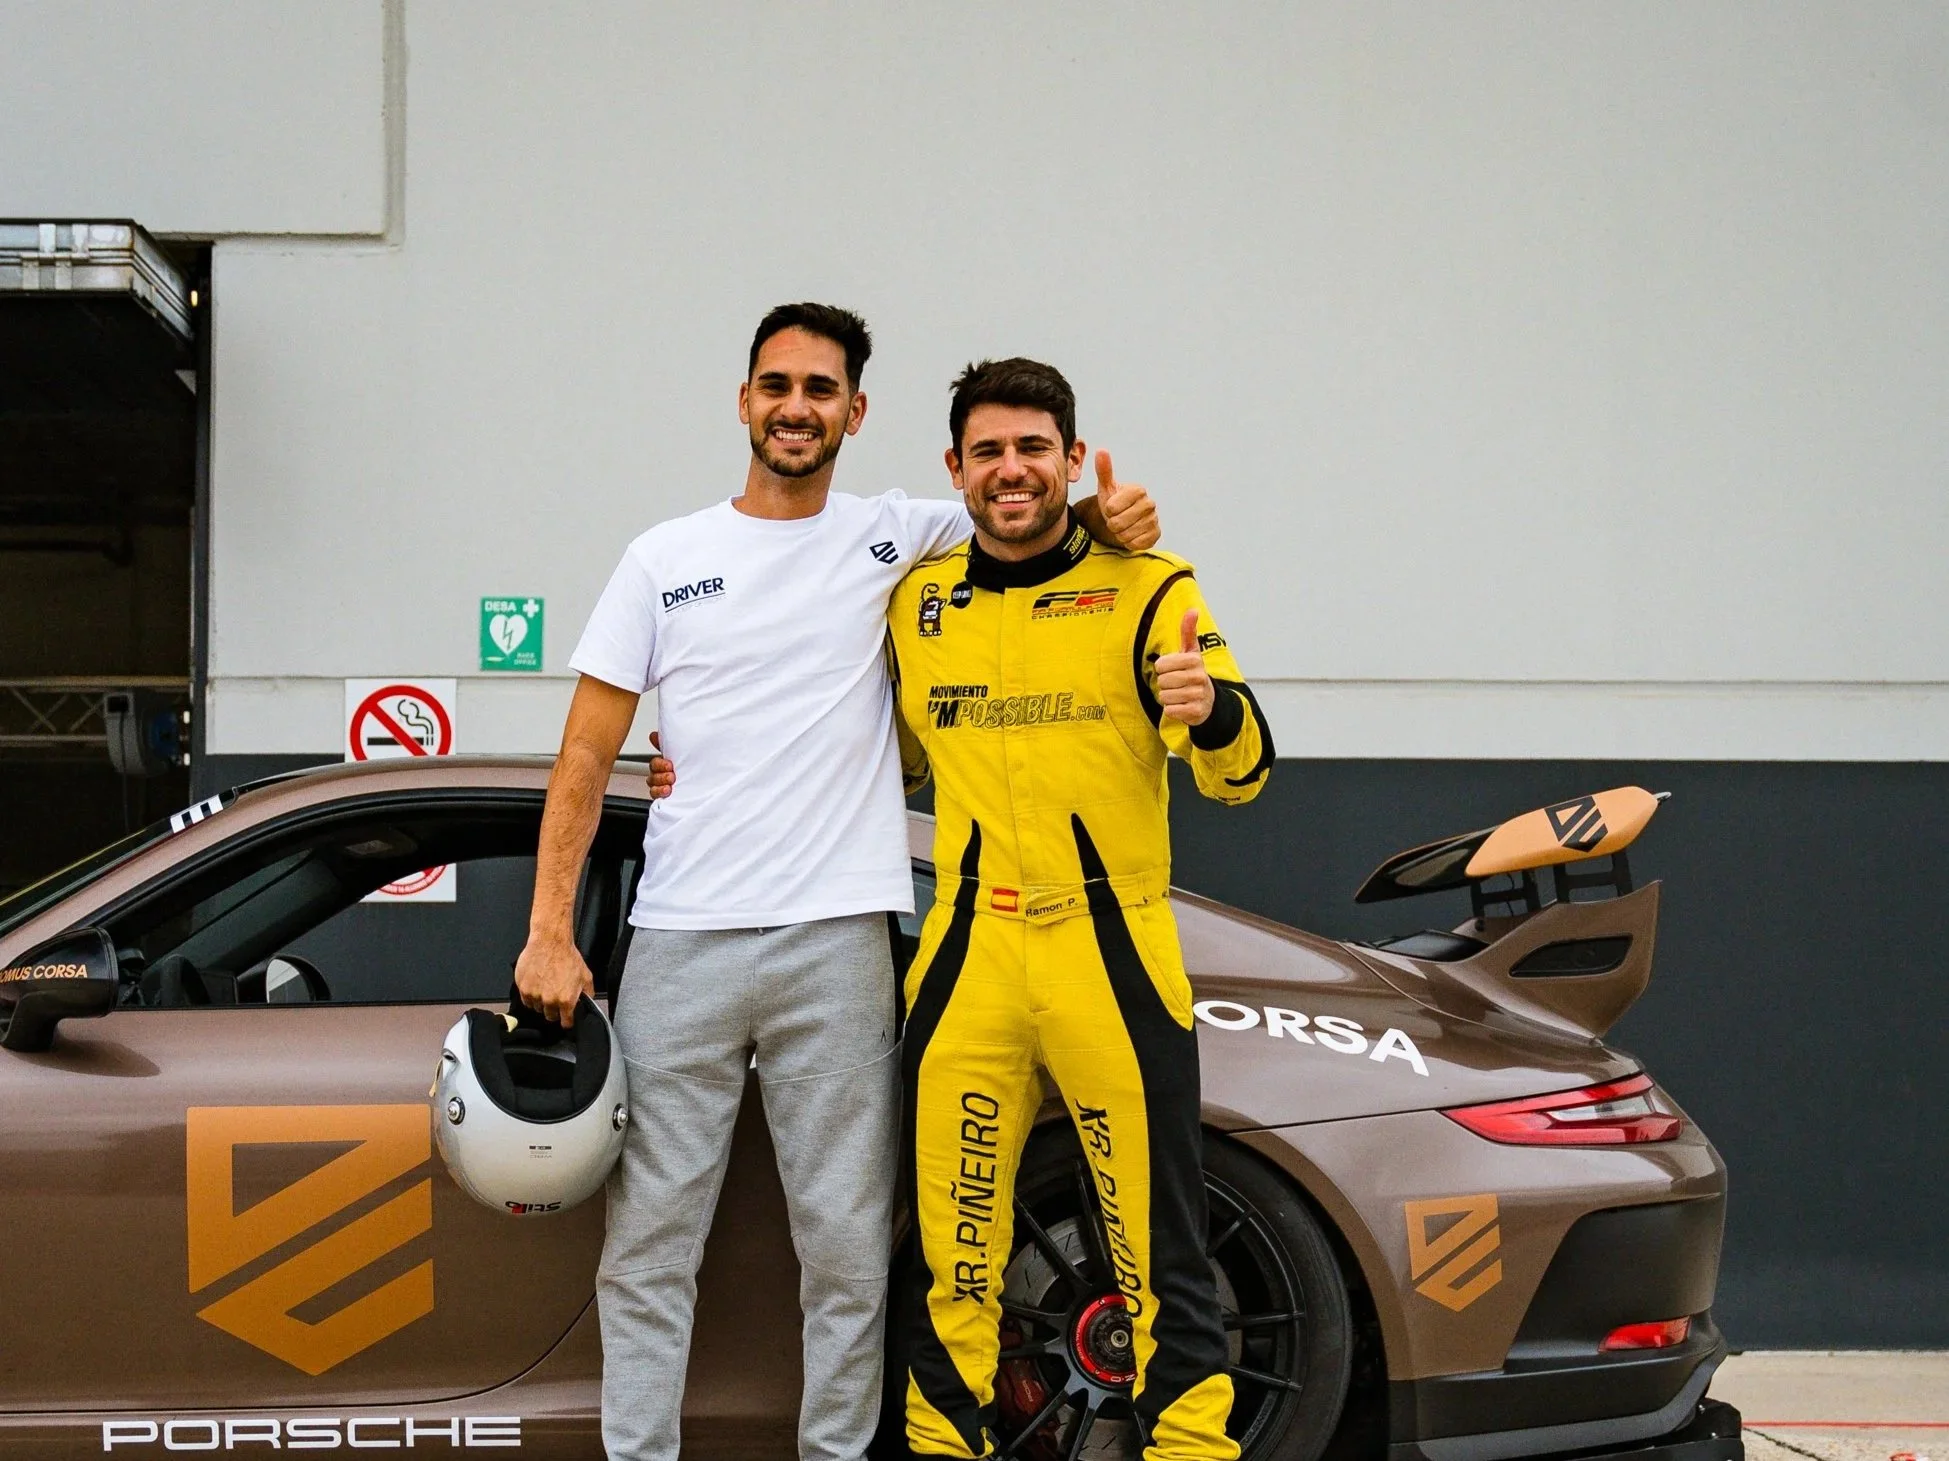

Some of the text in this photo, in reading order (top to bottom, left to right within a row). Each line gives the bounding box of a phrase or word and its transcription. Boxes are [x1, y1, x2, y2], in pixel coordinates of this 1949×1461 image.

[662, 577, 724, 608] DRIVER
[484, 600, 517, 612] DESA
[929, 685, 989, 699] MOVIMIENTO
[1025, 902, 1063, 918] Ramon
[33, 964, 88, 979] CORSA
[1192, 1000, 1430, 1077] ORSA
[102, 1416, 521, 1451] PORSCHE
